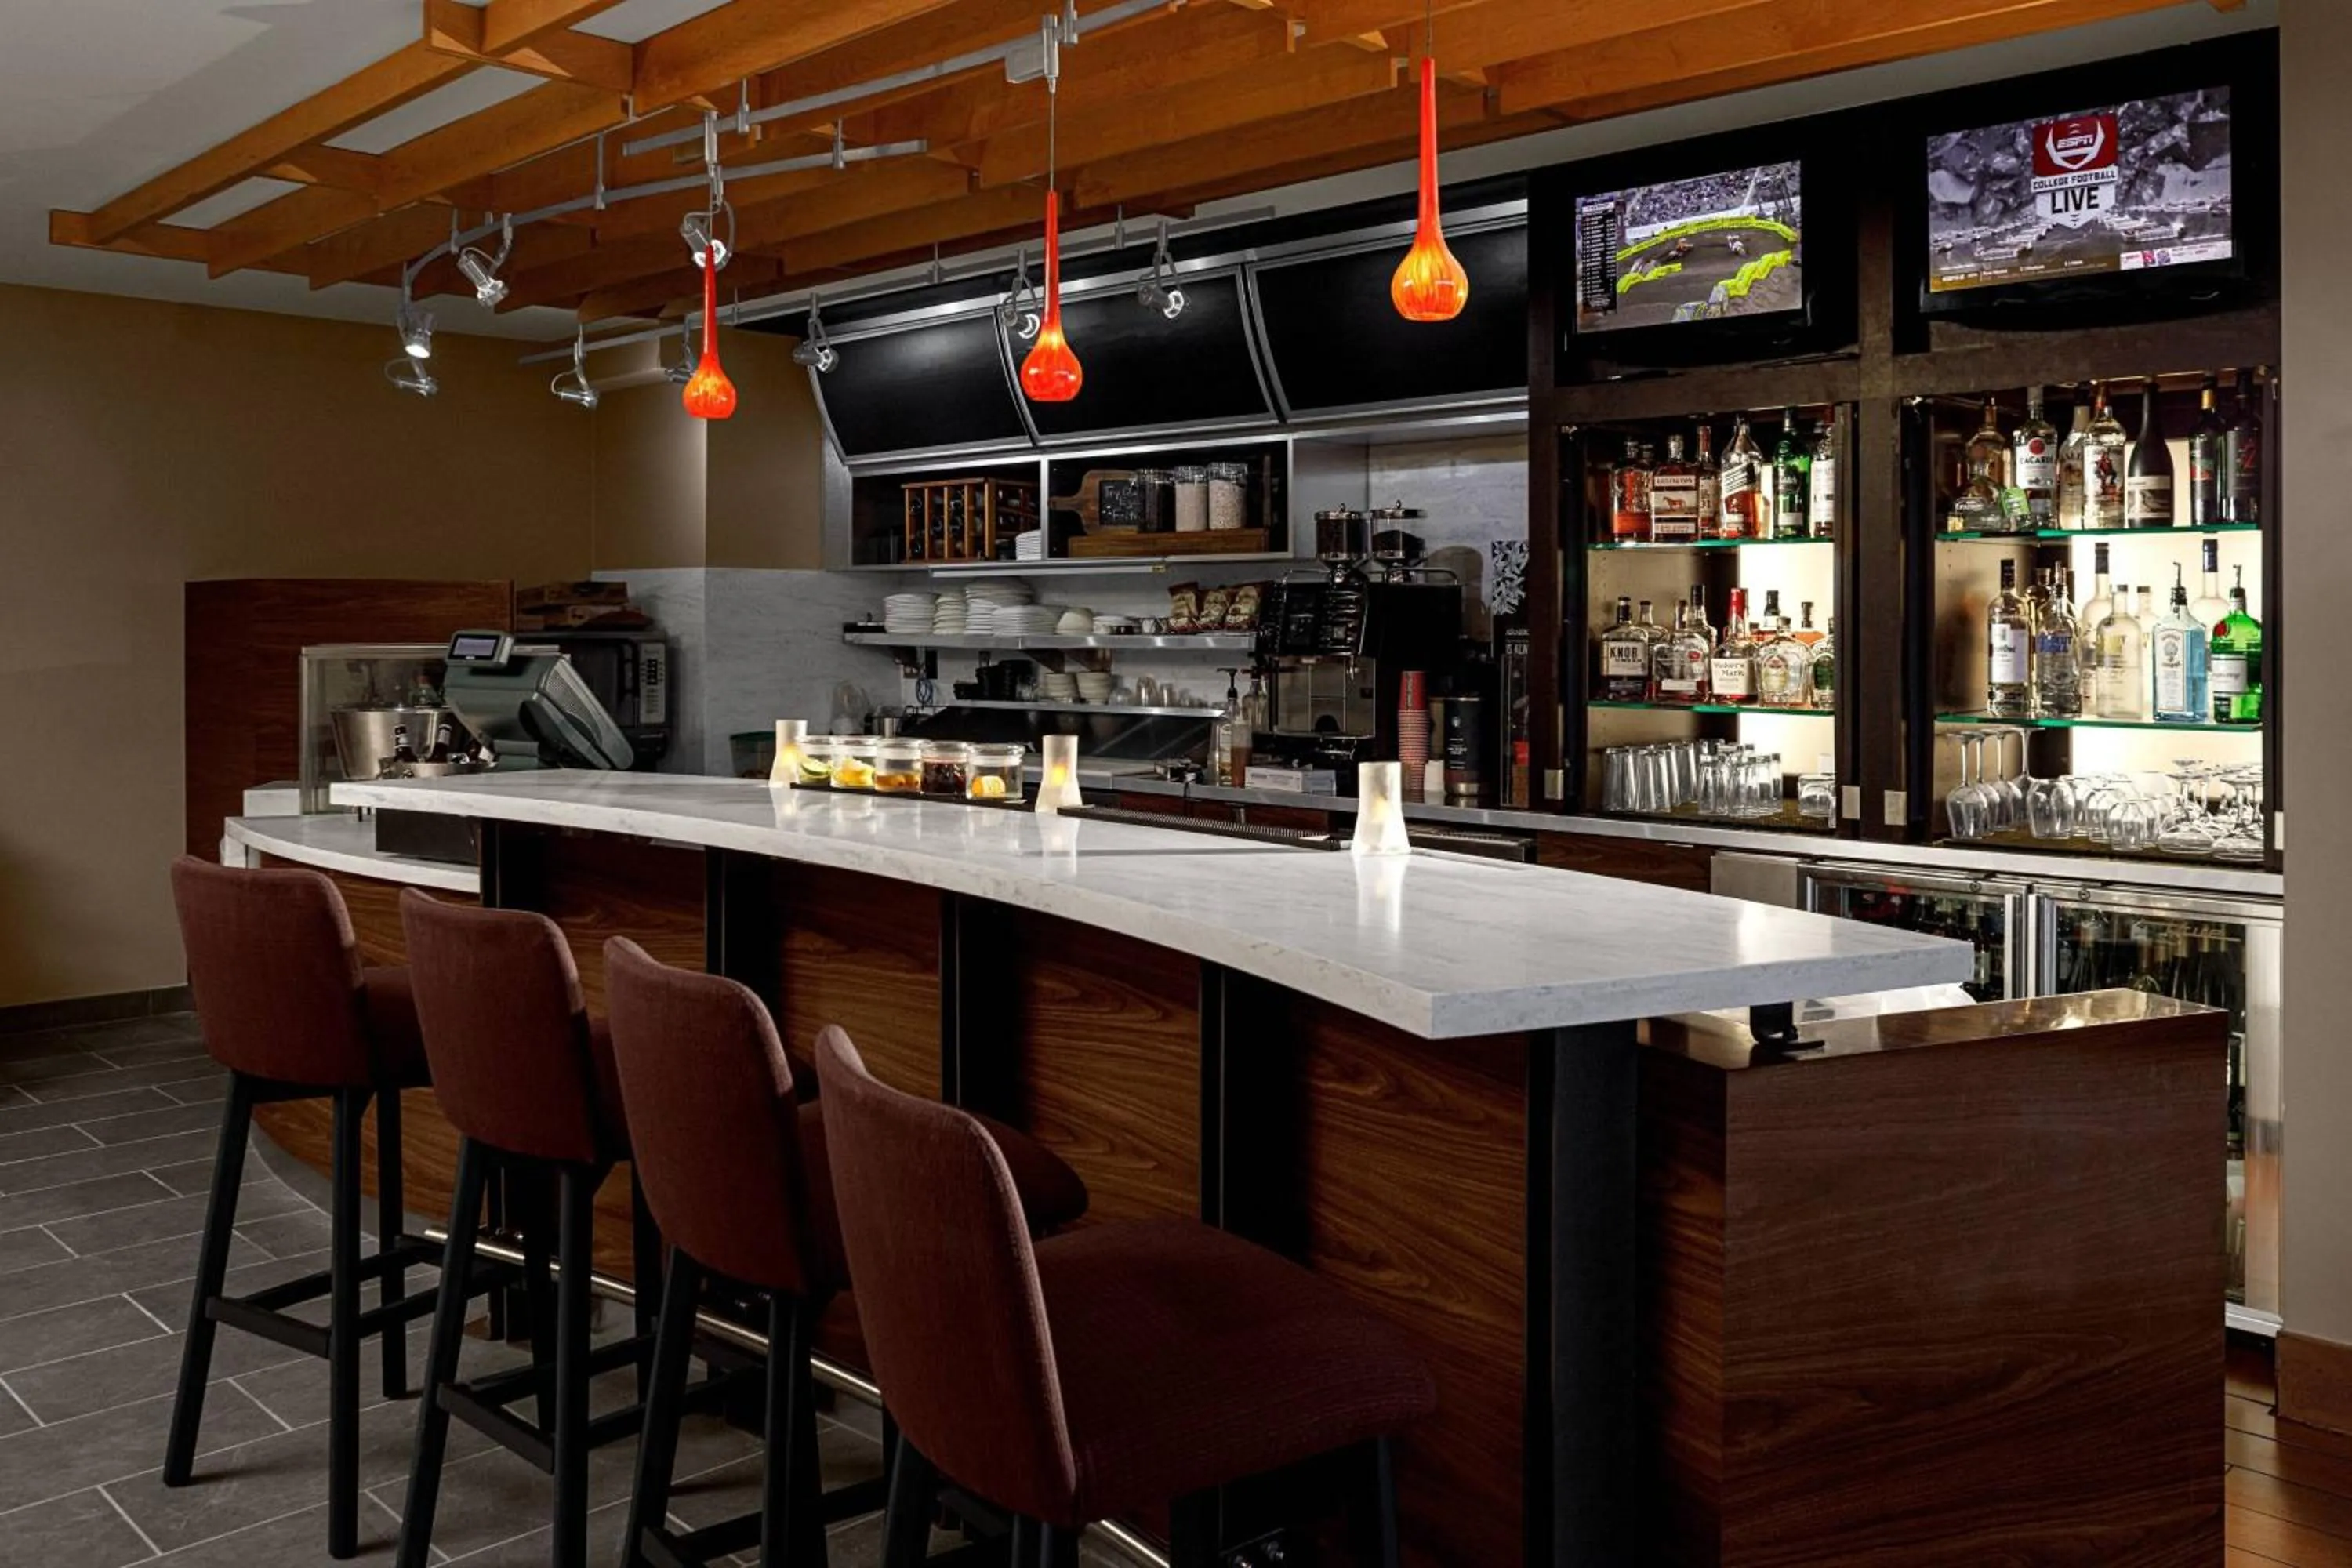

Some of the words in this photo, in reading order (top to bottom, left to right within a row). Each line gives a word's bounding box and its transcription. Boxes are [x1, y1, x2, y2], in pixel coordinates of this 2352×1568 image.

[2056, 135, 2093, 149] ESPN
[2033, 177, 2069, 190] COLLEGE
[2071, 171, 2116, 183] FOOTBALL
[2051, 187, 2100, 214] LIVE
